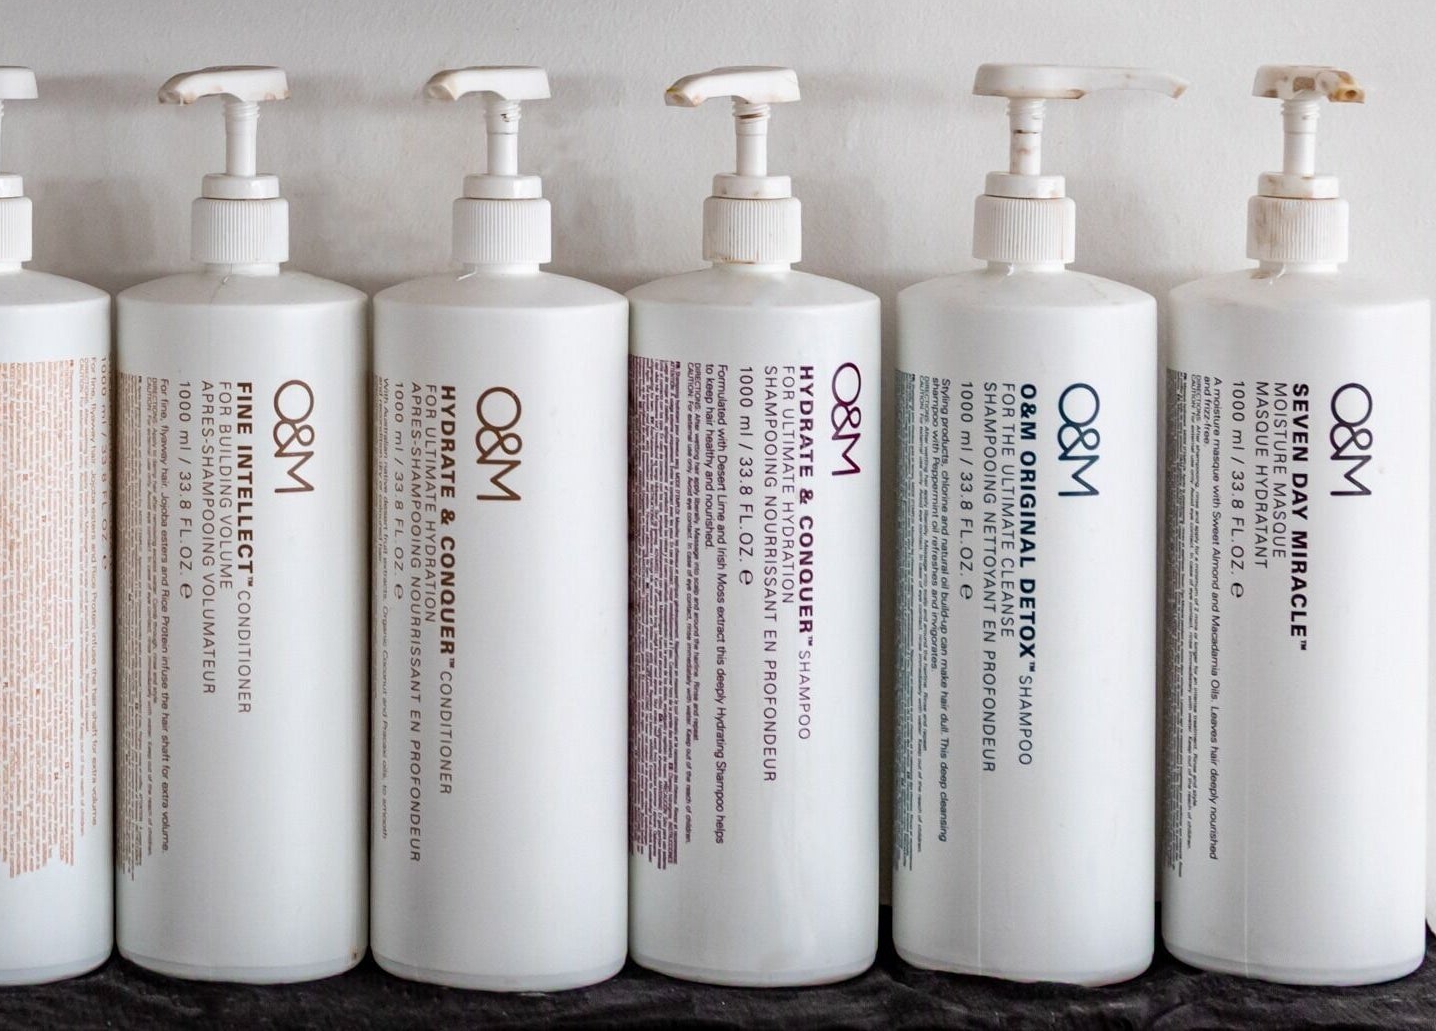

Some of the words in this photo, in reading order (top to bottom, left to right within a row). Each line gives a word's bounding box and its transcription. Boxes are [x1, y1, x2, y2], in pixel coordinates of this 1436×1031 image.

[178, 381, 192, 423] 1000
[218, 381, 233, 416] FOR
[236, 381, 253, 435] FINE
[424, 384, 438, 419] FOR
[713, 364, 729, 426] Formulated
[799, 365, 814, 478] HYDRATE
[830, 361, 862, 477] O&M
[1001, 382, 1016, 418] FOR
[1020, 383, 1038, 441] O&M
[1255, 381, 1270, 457] MASQUE
[1272, 382, 1288, 475] MOISTURE
[1292, 383, 1310, 462] SEVEN
[179, 430, 192, 451] ml
[201, 380, 216, 567] APRES-SHAMPOOING
[218, 424, 233, 509] BUILDING
[272, 379, 316, 494] O&M
[424, 426, 437, 513] ULTIMATE
[440, 385, 457, 499] HYDRATE
[474, 386, 523, 502] O&M
[713, 427, 728, 453] with
[713, 454, 729, 492] Desert
[982, 381, 998, 504] SHAMPOOING
[1001, 423, 1016, 457] THE
[1056, 382, 1101, 497] O&M
[1329, 382, 1374, 497] O&M
[178, 471, 192, 510] 33.8
[440, 508, 456, 526] &
[713, 494, 728, 522] Lime
[799, 487, 814, 505] &
[1000, 464, 1016, 550] ULTIMATE
[1019, 450, 1037, 568] ORIGINAL
[1254, 464, 1269, 569] HYDRATANT
[1272, 482, 1288, 558] MASQUE
[1291, 472, 1309, 521] DAY
[179, 517, 193, 576] FL.OZ.
[219, 514, 233, 589] VOLUME
[423, 520, 437, 623] HYDRATION
[713, 523, 728, 545] and
[713, 545, 728, 571] Irish
[982, 511, 997, 613] NETTOYANT
[716, 572, 728, 604] Moss
[716, 605, 726, 644] extract
[1000, 557, 1015, 638] CLEANSE
[202, 572, 216, 694] VOLUMATEUR
[237, 590, 252, 713] CONDITIONER
[716, 645, 728, 666] this
[982, 619, 997, 643] EN
[713, 667, 727, 705] deeply
[798, 650, 811, 740] SHAMPOO
[981, 649, 997, 772] PROFONDEUR
[1018, 675, 1033, 766] SHAMPOO
[439, 671, 453, 794] CONDITIONER
[713, 706, 727, 759] Hydrating
[713, 760, 727, 813] Shampoo
[713, 814, 726, 844] helps
